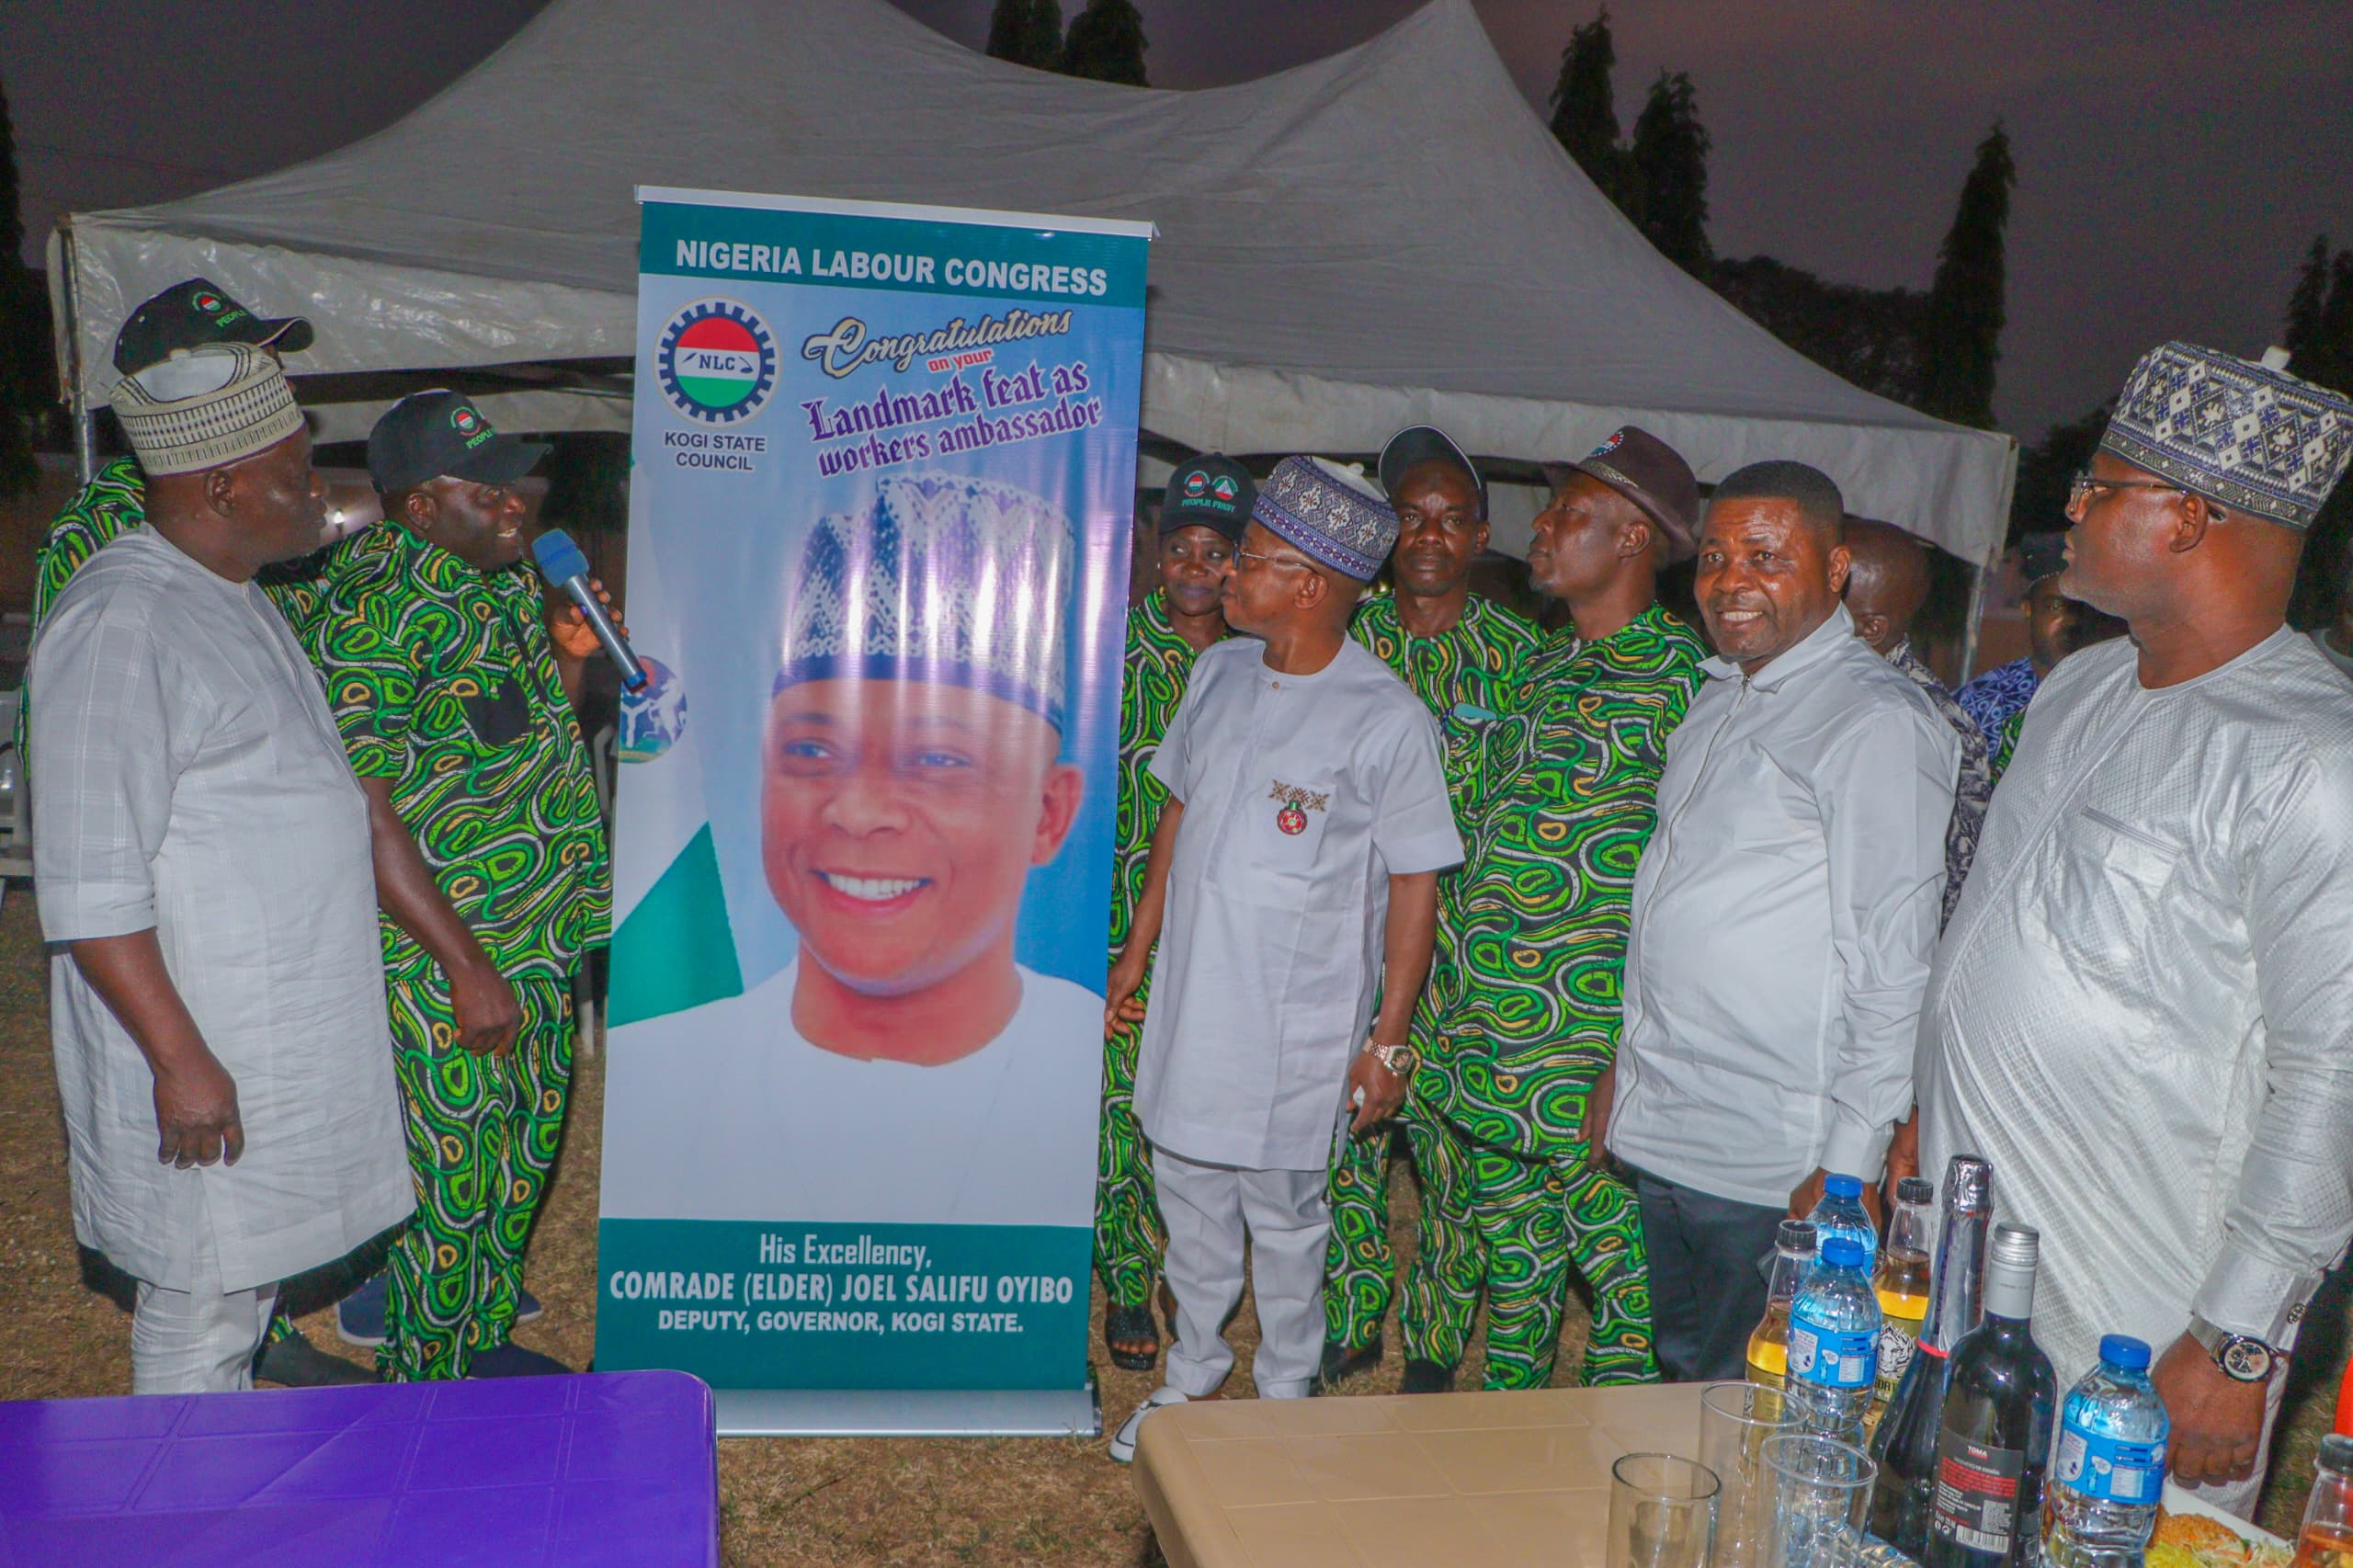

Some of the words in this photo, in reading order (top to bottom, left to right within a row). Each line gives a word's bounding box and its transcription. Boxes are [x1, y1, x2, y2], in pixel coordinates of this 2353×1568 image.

[677, 239, 802, 274] NIGERIA
[812, 248, 935, 284] LABOUR
[944, 258, 1107, 295] CONGRESS
[215, 310, 247, 328] PEOPL
[801, 309, 1074, 380] Congratulations
[699, 354, 736, 370] NLC
[927, 358, 950, 371] on
[952, 350, 993, 370] your
[801, 374, 978, 441] Landmark
[982, 359, 1046, 409] feat
[1053, 362, 1089, 395] as
[665, 431, 708, 449] KOGI
[712, 435, 766, 452] STATE
[818, 433, 931, 477] workers
[938, 398, 1101, 454] ambassador
[676, 451, 753, 471] COUNCIL
[760, 1233, 796, 1264] His
[804, 1233, 932, 1272] Excellency,
[609, 1270, 734, 1300] COMRADE
[744, 1272, 833, 1307] (ELDER)
[841, 1274, 897, 1301] JOEL
[905, 1274, 988, 1302] SALIFU
[996, 1275, 1074, 1303] OYIBO
[658, 1310, 750, 1335] DEPUTY,
[756, 1311, 885, 1335] GOVERNOR,
[892, 1312, 945, 1332] KOGI
[951, 1312, 1024, 1332] STATE.
